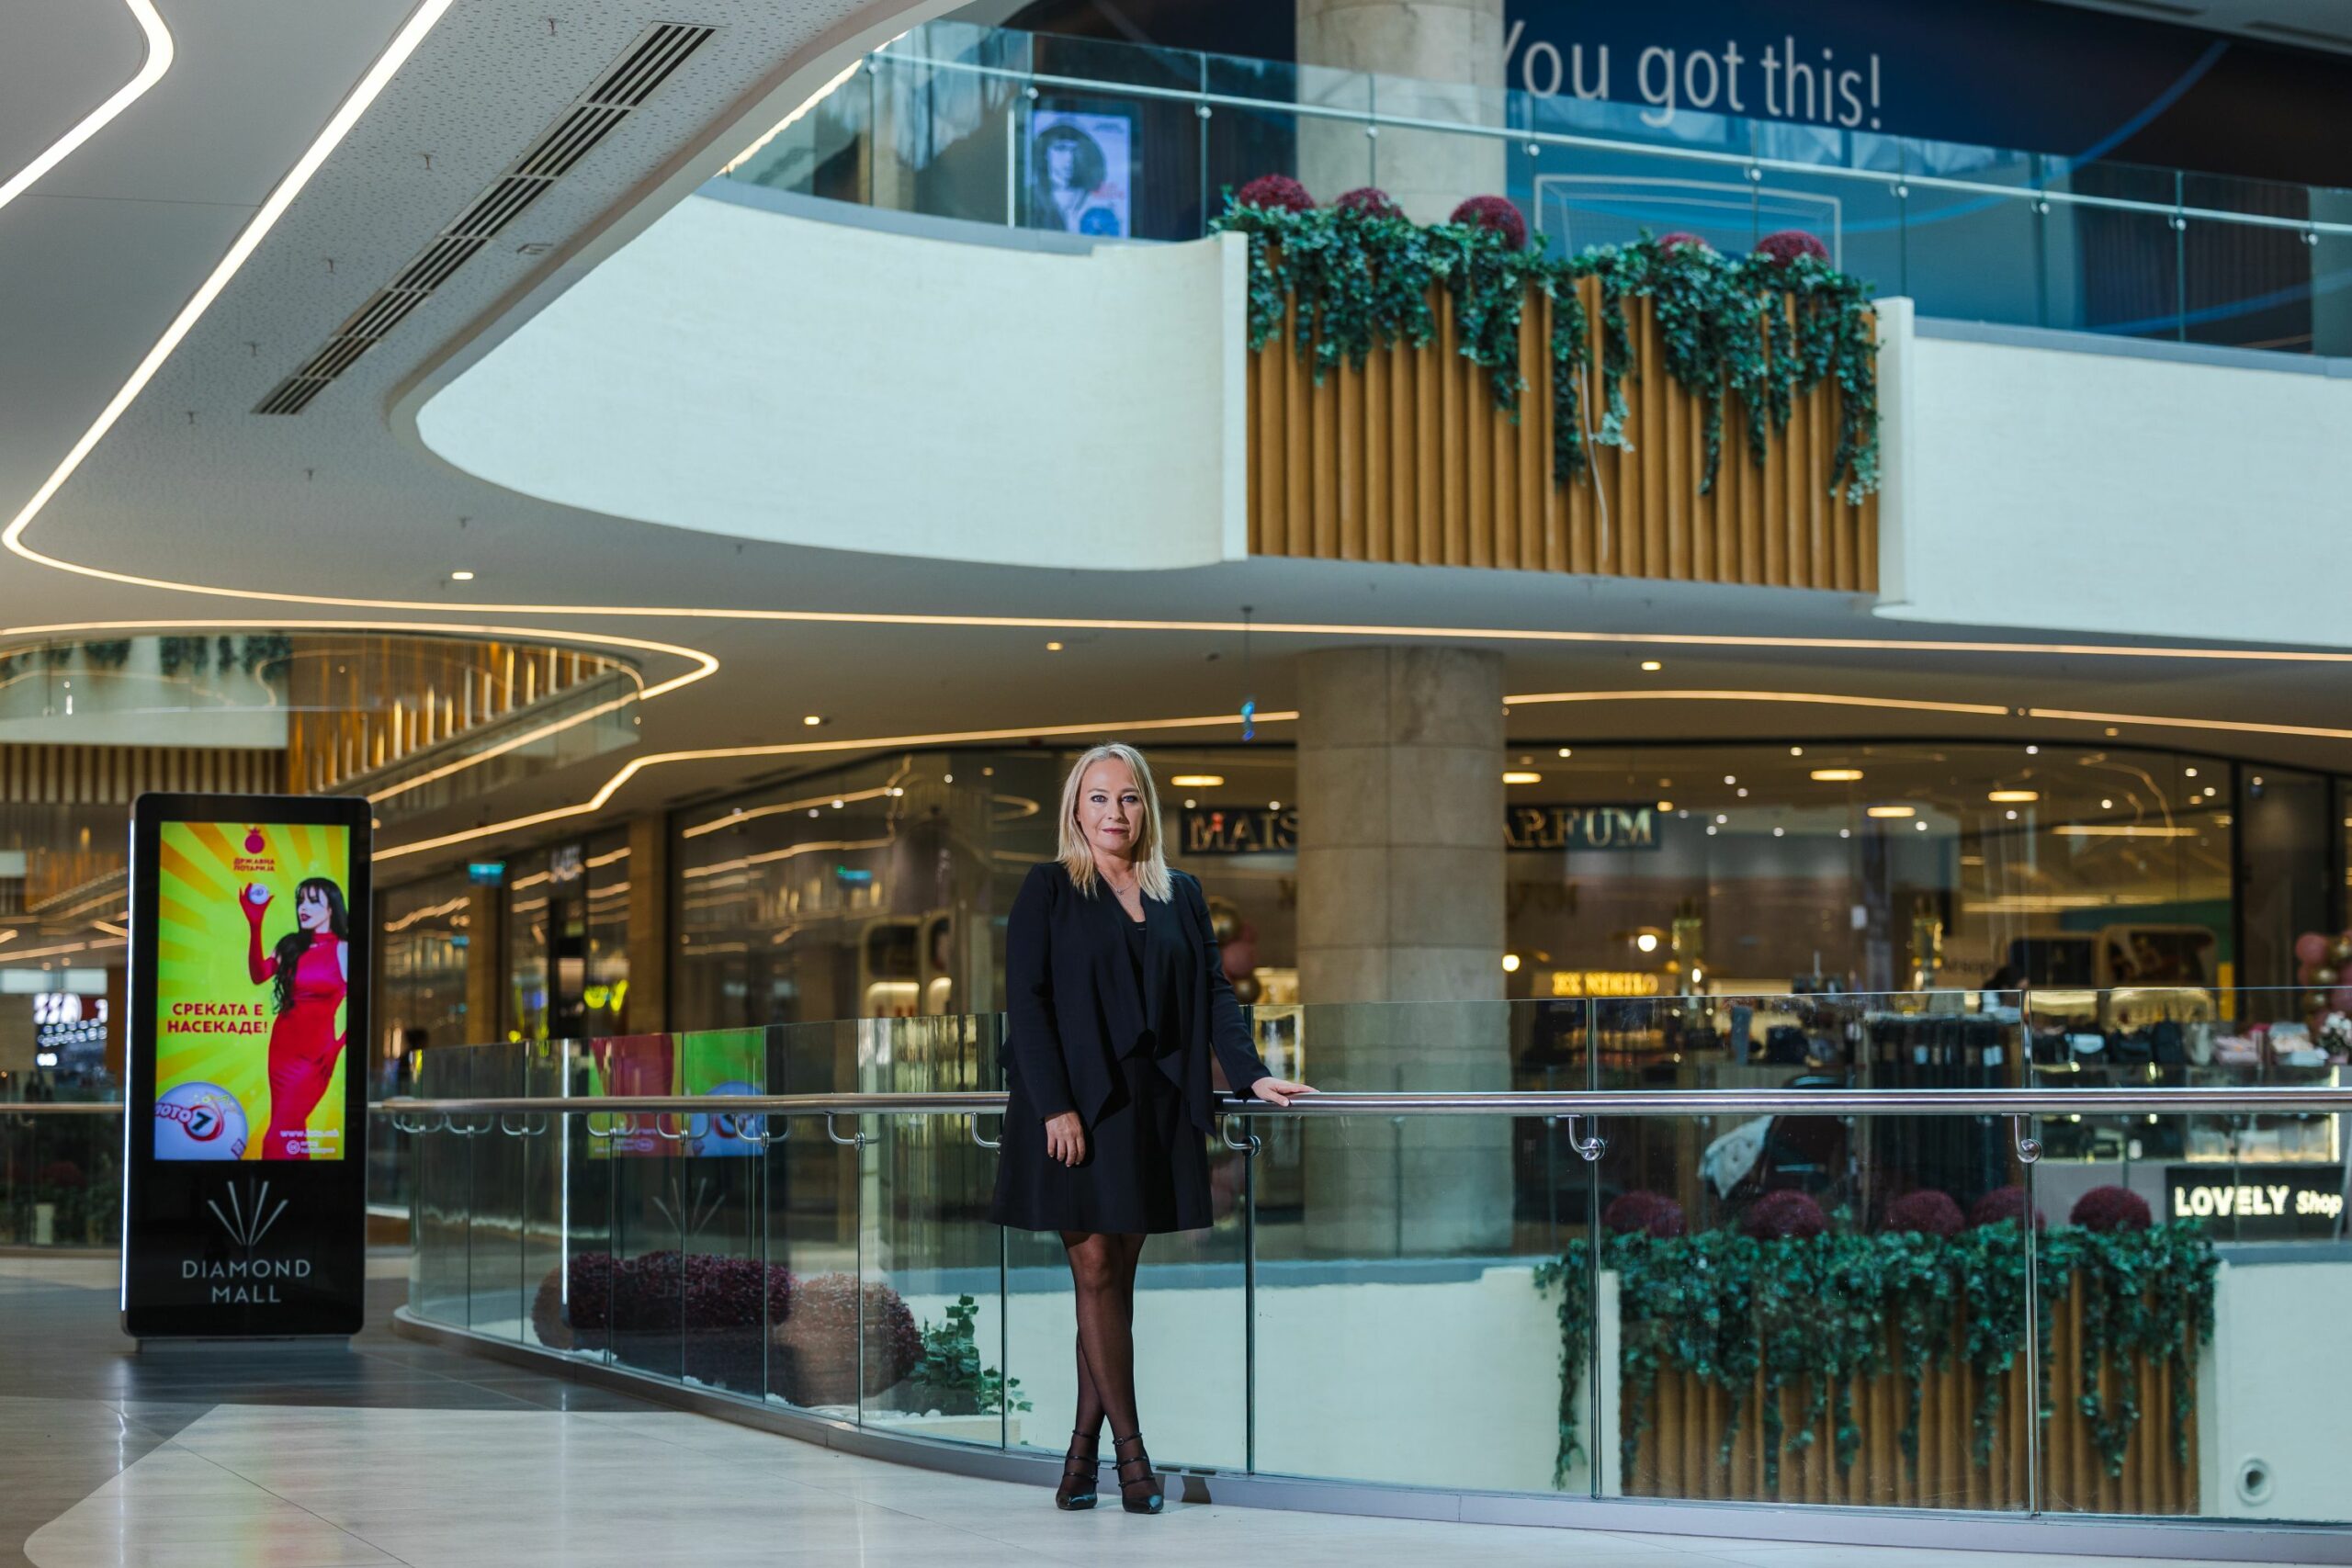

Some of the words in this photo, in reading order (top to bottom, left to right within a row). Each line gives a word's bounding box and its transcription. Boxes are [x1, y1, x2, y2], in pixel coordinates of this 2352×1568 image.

[1637, 39, 1746, 128] got
[1760, 35, 1882, 130] this!
[167, 1021, 268, 1035] НАСЕКАДЕ!
[191, 1111, 213, 1132] 7
[2175, 1184, 2290, 1217] LOVELY
[2295, 1190, 2344, 1219] Shop
[182, 1259, 311, 1279] DIAMOND
[212, 1285, 282, 1303] MALL
